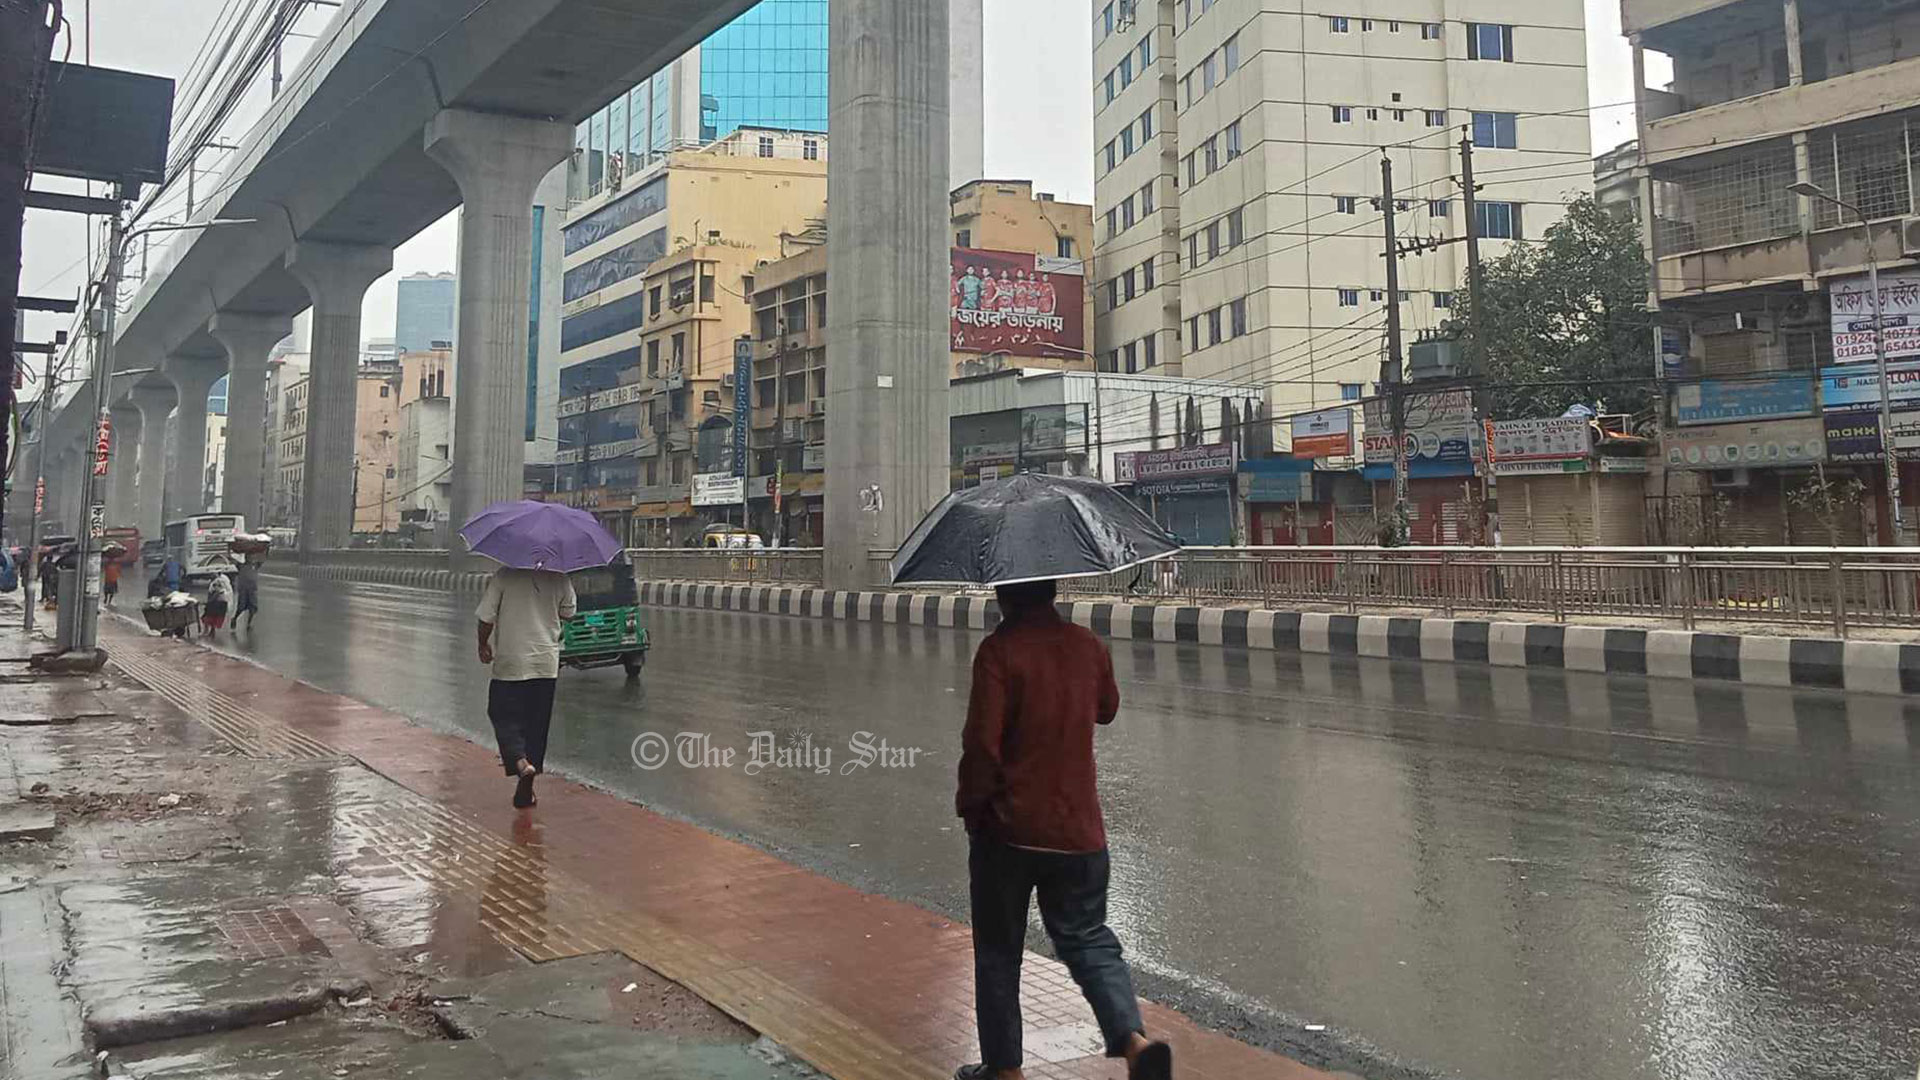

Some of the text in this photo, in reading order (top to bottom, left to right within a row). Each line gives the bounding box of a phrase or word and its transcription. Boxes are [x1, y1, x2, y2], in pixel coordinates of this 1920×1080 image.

[1834, 285, 1863, 312] অফিস
[957, 308, 1001, 328] জয়ের
[1364, 435, 1398, 451] STA
